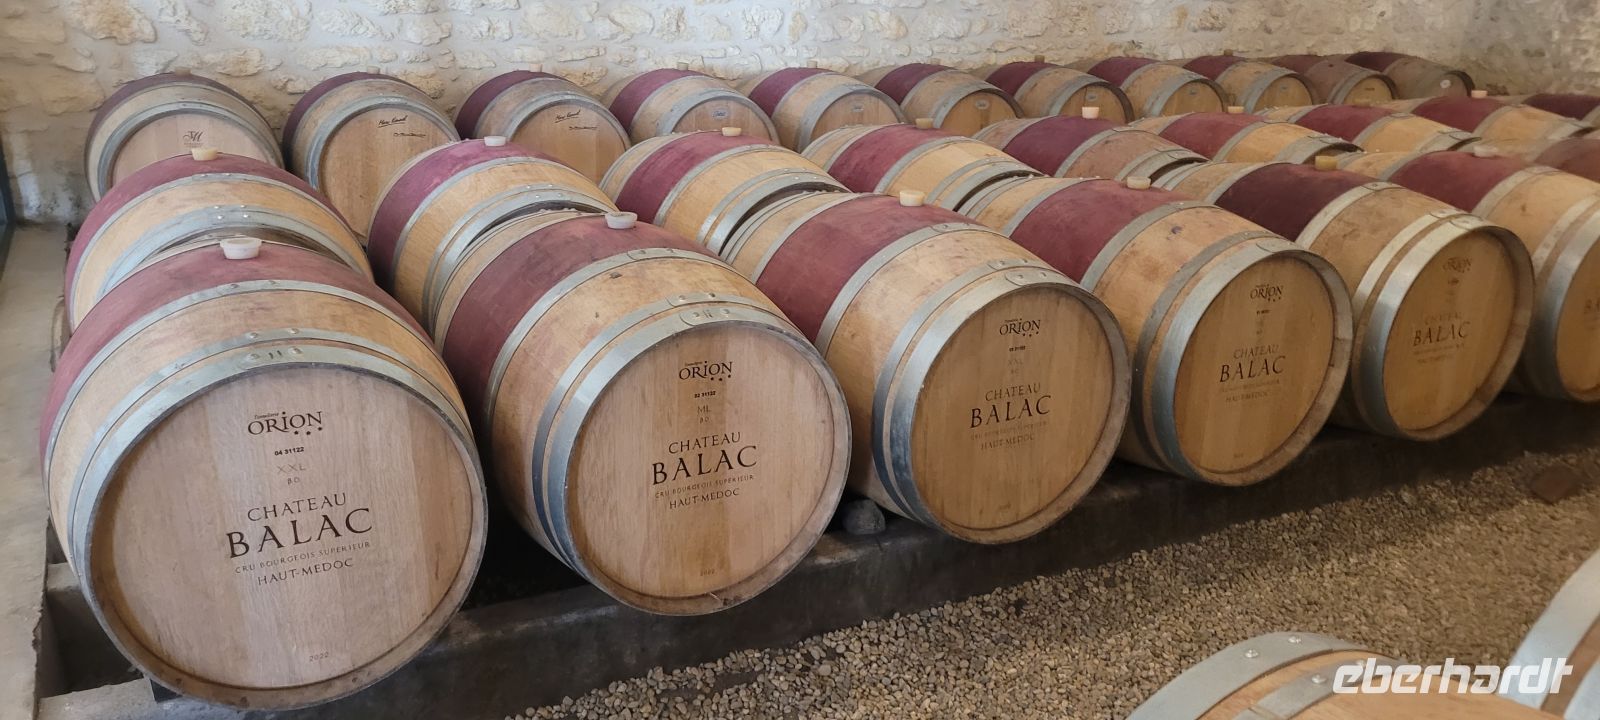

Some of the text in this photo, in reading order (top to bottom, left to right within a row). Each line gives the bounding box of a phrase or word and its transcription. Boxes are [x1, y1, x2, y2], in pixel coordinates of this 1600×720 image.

[1219, 355, 1286, 383] BALAC
[985, 382, 1041, 401] CHATEAU
[969, 395, 1052, 429] BALAC
[284, 446, 305, 455] 31122
[668, 431, 741, 454] CHATEAU
[276, 463, 307, 475] XXL
[652, 445, 757, 485] BALAC
[247, 492, 347, 522] CHATEAU
[655, 490, 671, 499] CRU
[669, 487, 741, 510] HAUT-MEDOC
[226, 507, 373, 559] BALAC
[235, 541, 371, 574] CRU BOURGEOIS SUPERIEUR
[257, 558, 353, 586] HAUT-MEDOC
